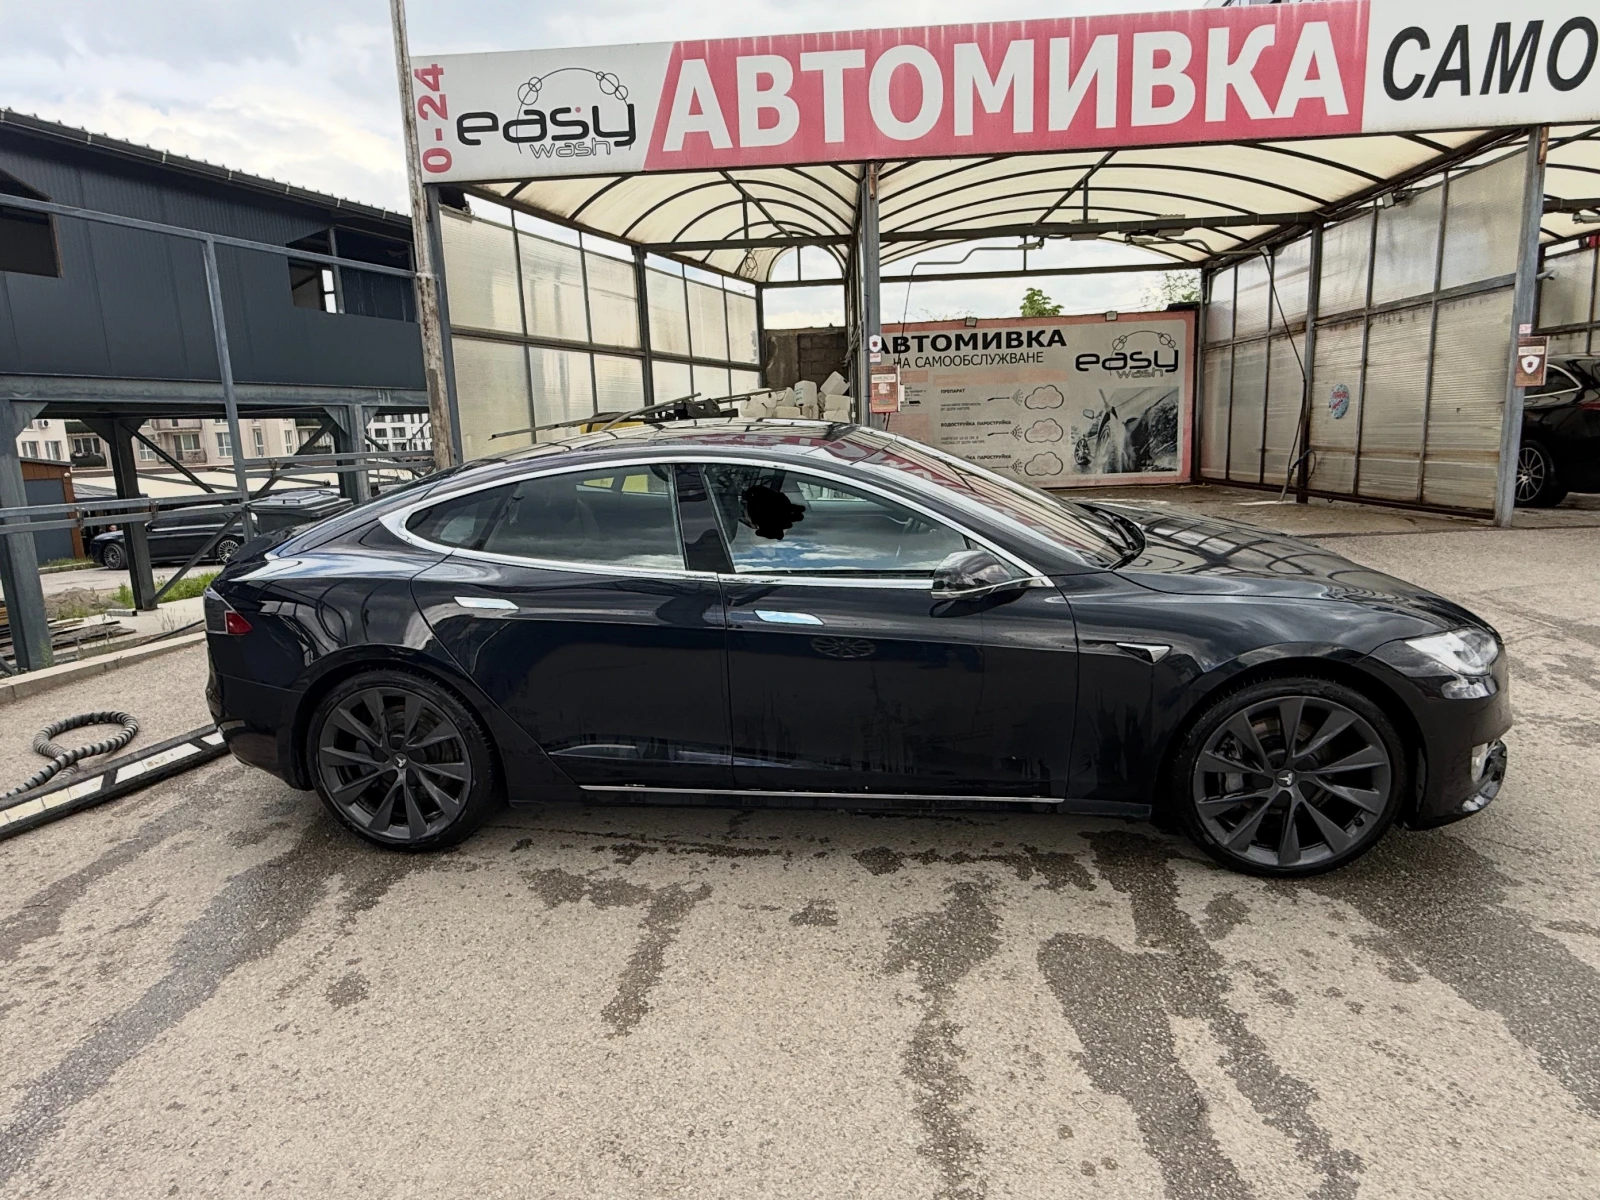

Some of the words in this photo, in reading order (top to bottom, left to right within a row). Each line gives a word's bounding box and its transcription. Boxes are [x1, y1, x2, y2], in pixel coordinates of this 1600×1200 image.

[662, 21, 1349, 152] АВТОМИВКА
[1383, 16, 1599, 101] САМО
[414, 63, 453, 174] 0-24
[456, 103, 636, 147] easy
[530, 138, 611, 158] wash
[915, 352, 1044, 368] САМООБСЛУЖВАНЕ
[1075, 350, 1179, 372] easy
[1116, 367, 1163, 378] wash
